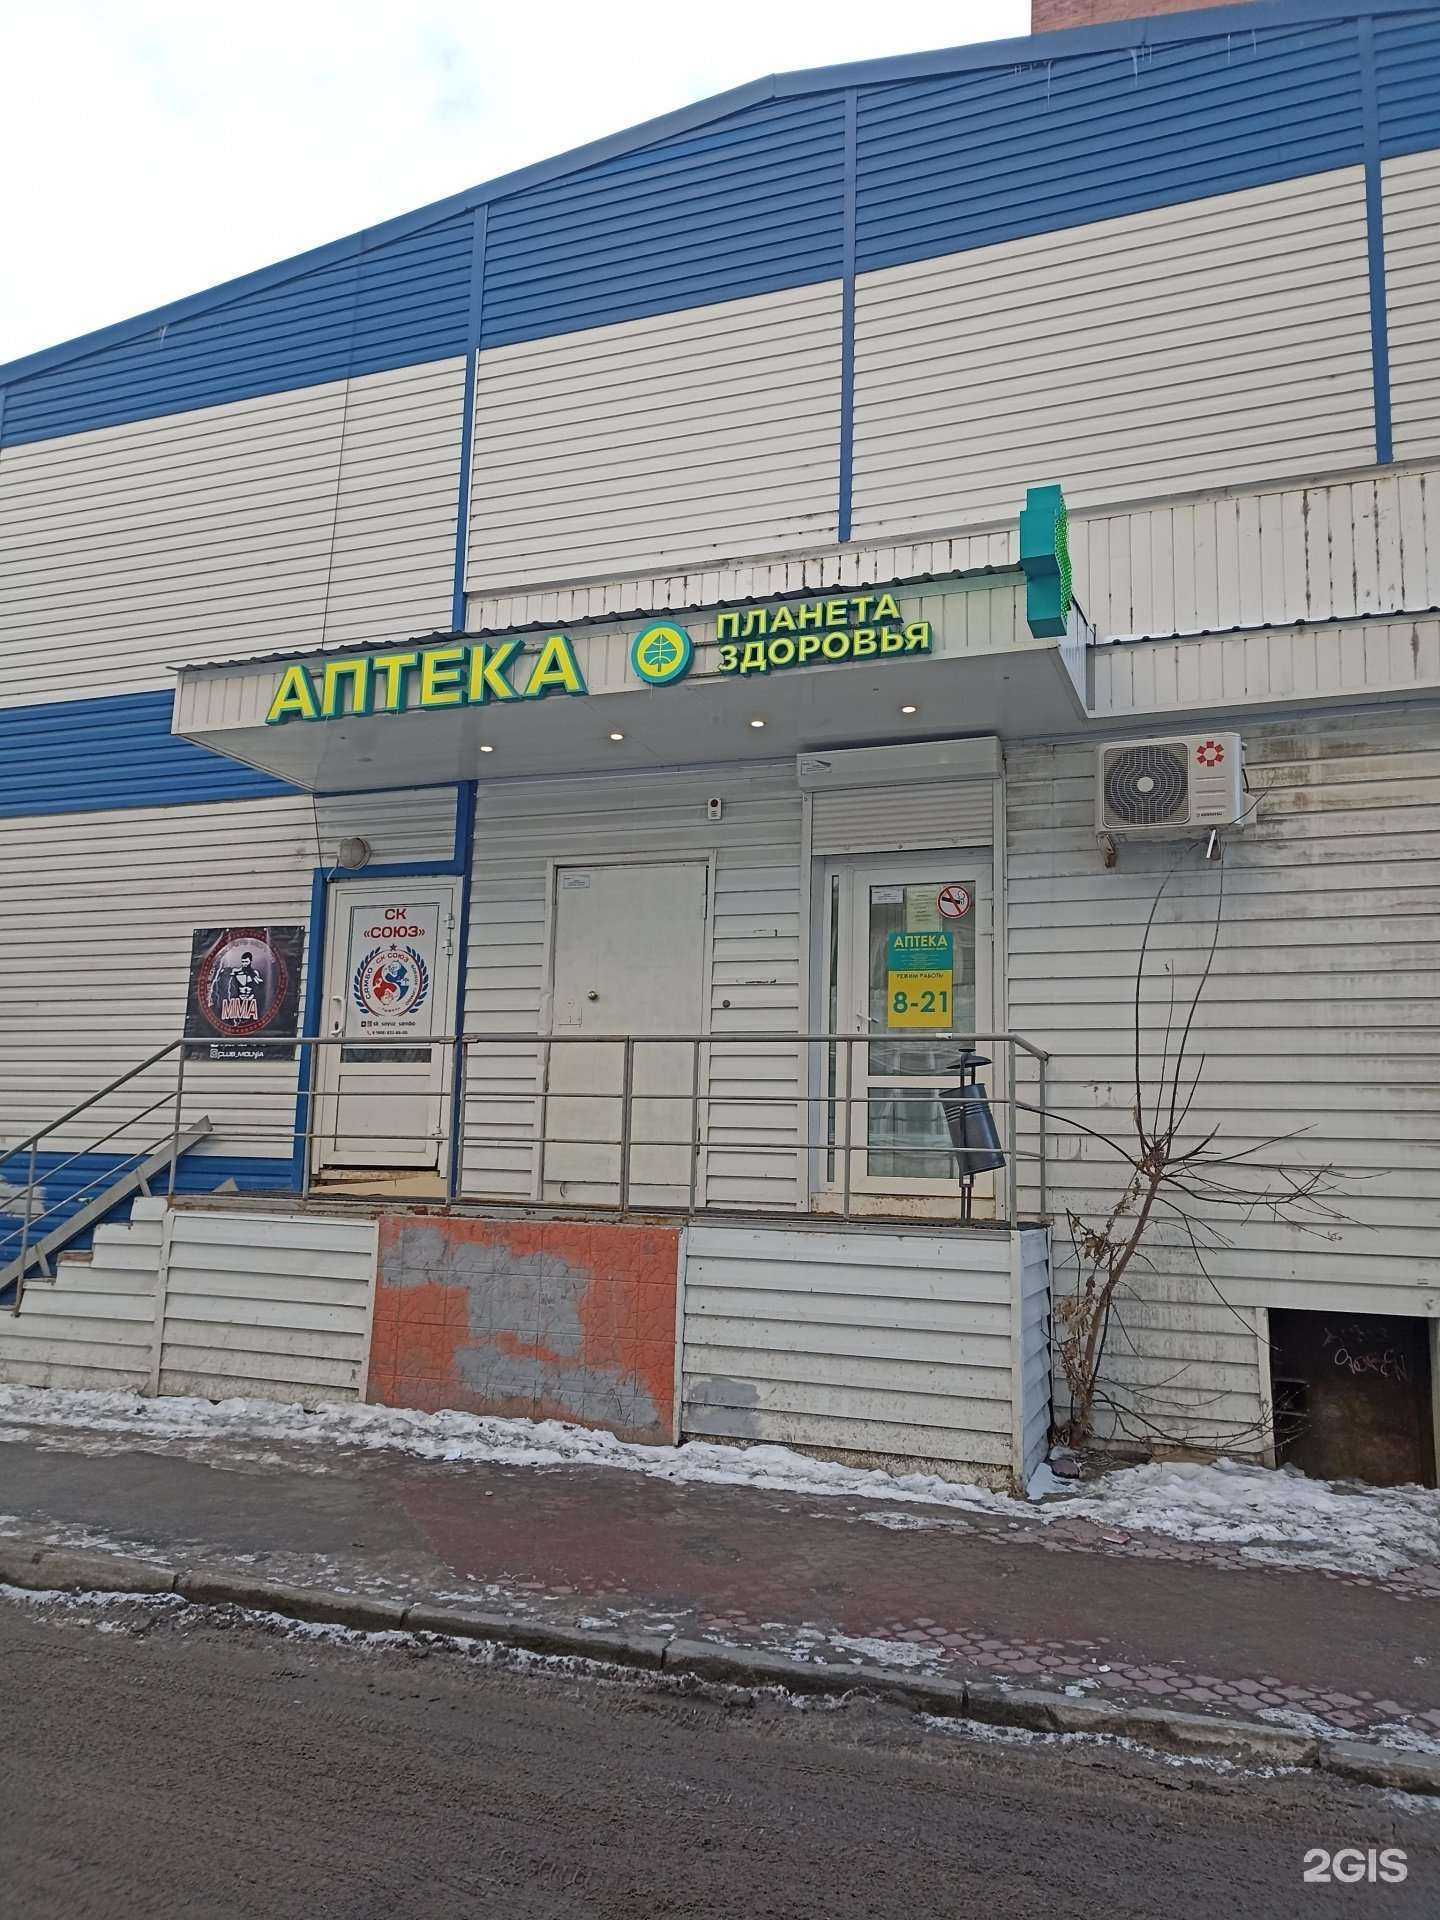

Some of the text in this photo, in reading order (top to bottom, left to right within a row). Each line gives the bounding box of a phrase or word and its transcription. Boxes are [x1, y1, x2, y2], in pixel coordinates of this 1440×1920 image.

[717, 593, 903, 641] ПЛАНЕТА
[718, 621, 933, 675] ЗДОРОВЬЯ
[265, 634, 587, 725] АПТЕКА
[384, 908, 407, 920] СК
[363, 925, 426, 939] «СОЮЗ»
[893, 934, 948, 948] АПТЕКА
[893, 991, 948, 1014] 8-21
